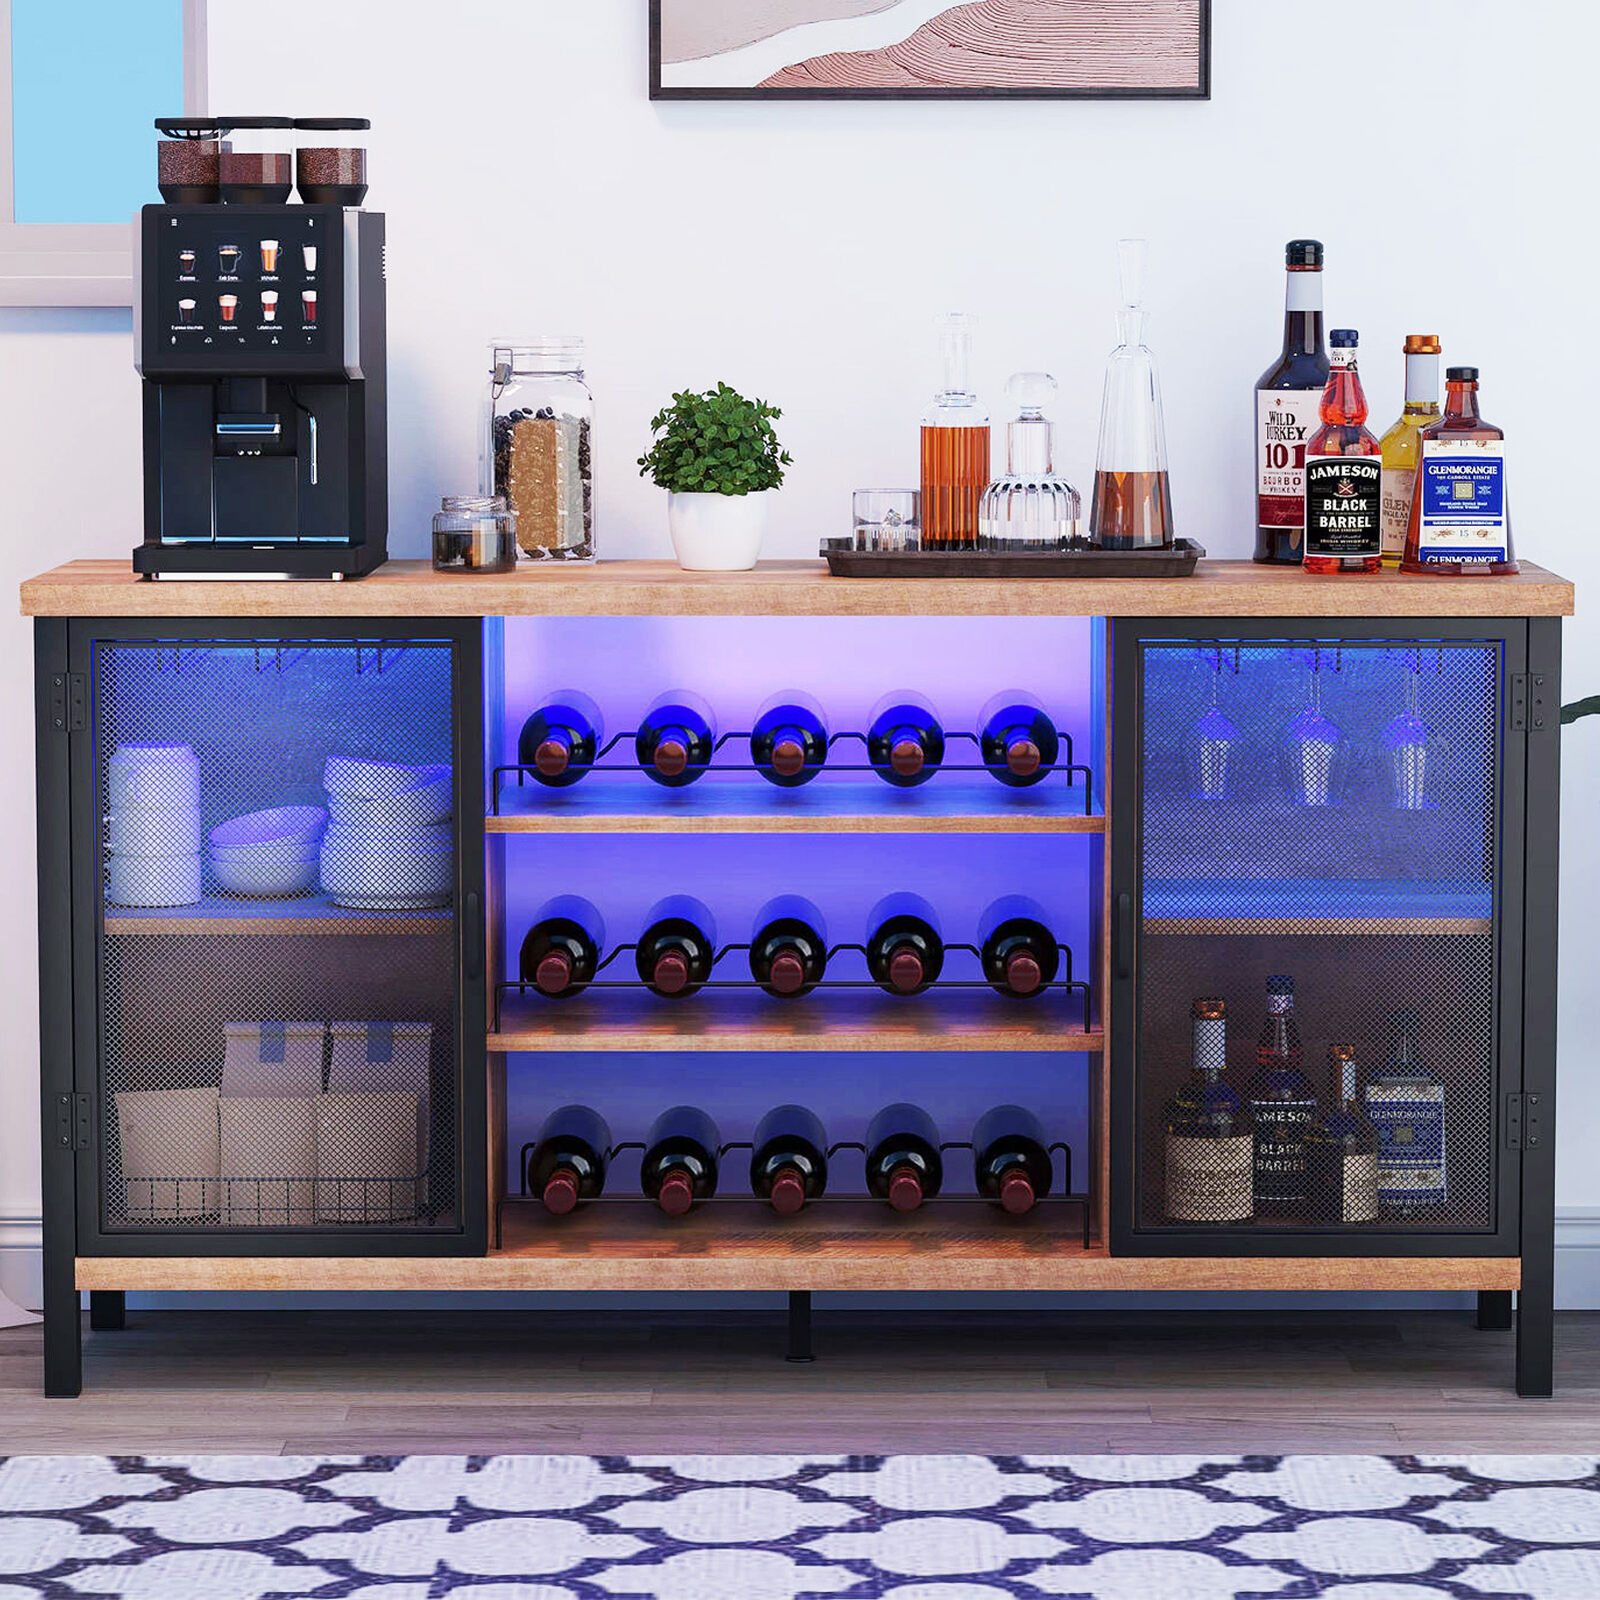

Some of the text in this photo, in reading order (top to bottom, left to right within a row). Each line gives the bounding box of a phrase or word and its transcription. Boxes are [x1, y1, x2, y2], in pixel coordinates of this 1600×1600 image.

[1268, 411, 1296, 426] WILD
[1265, 422, 1307, 442] TURKEY
[1265, 443, 1307, 469] 101
[1310, 465, 1378, 480] JAMESON
[1428, 465, 1498, 475] GLENMORANGIE
[1263, 476, 1302, 486] BOURBO
[1323, 498, 1367, 511] BLACK
[1319, 516, 1372, 528] BARREL
[1459, 529, 1470, 537] 15
